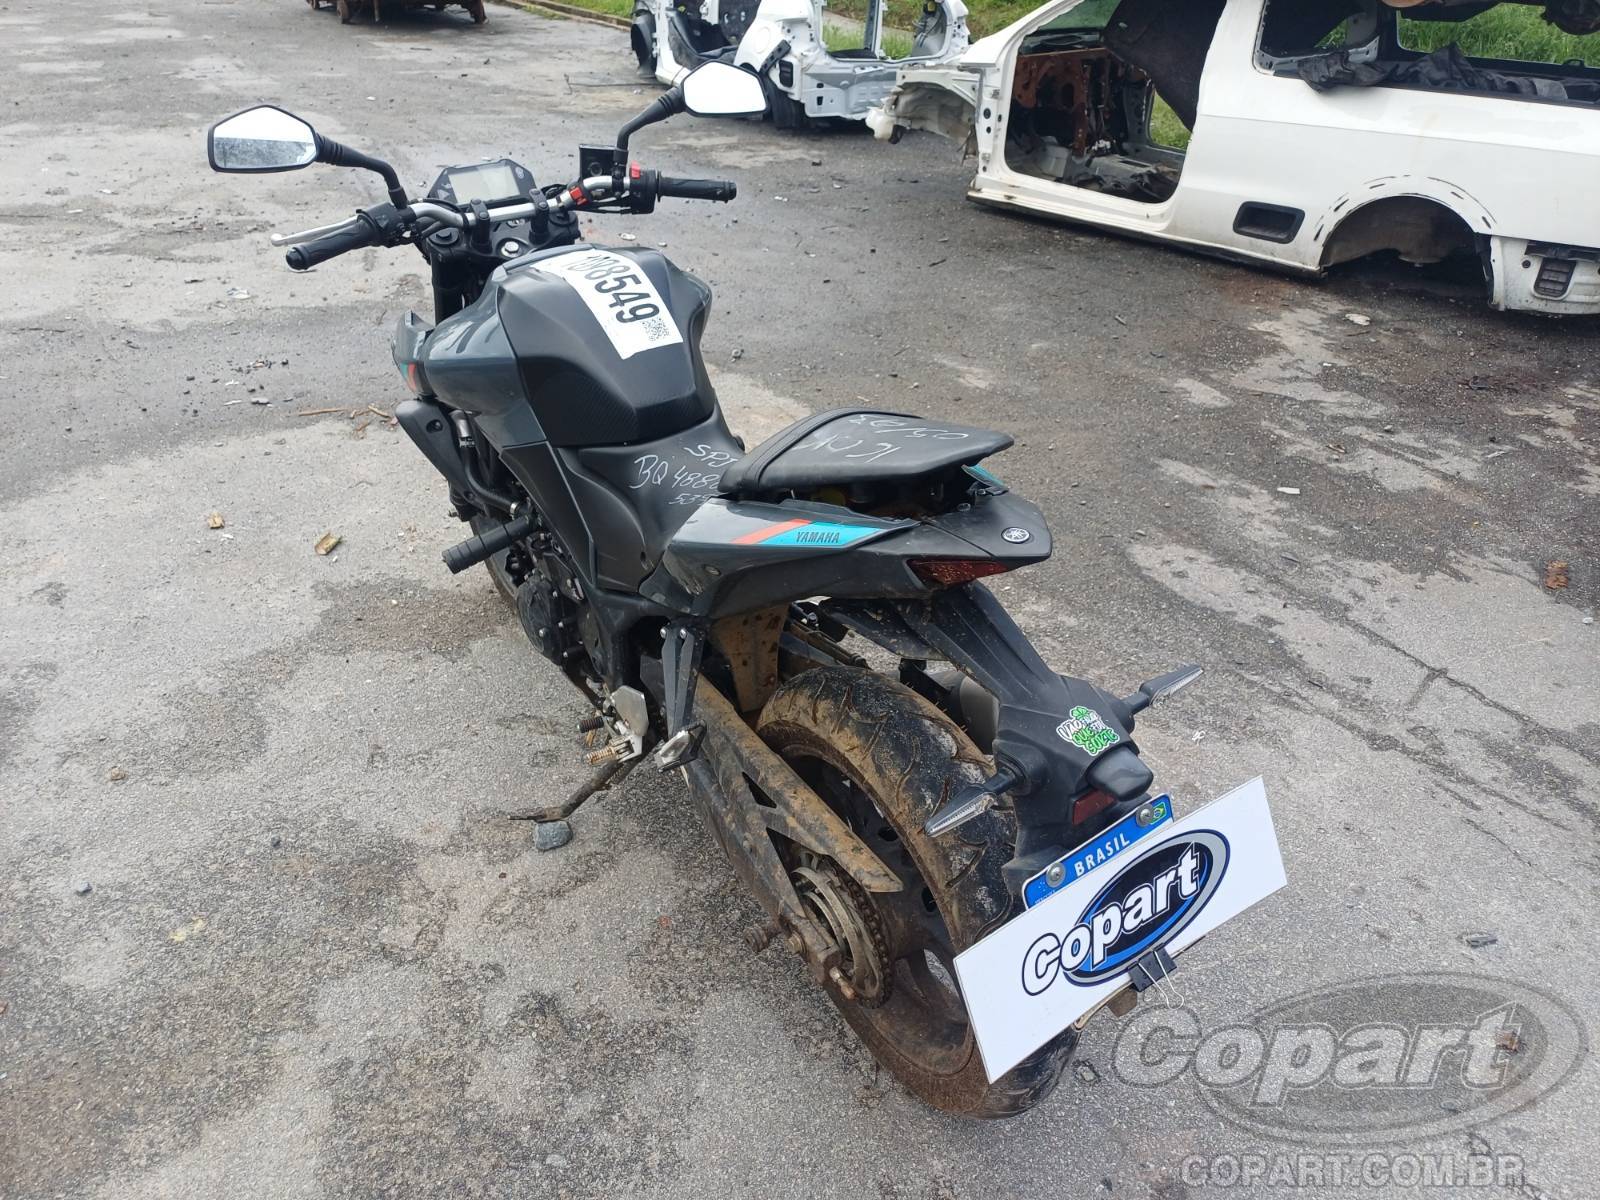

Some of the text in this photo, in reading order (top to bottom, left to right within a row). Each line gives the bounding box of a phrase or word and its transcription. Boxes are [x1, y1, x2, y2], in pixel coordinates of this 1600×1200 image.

[796, 531, 840, 544] YAMAHA
[1073, 832, 1131, 877] BRASIL
[1021, 841, 1202, 996] Copart
